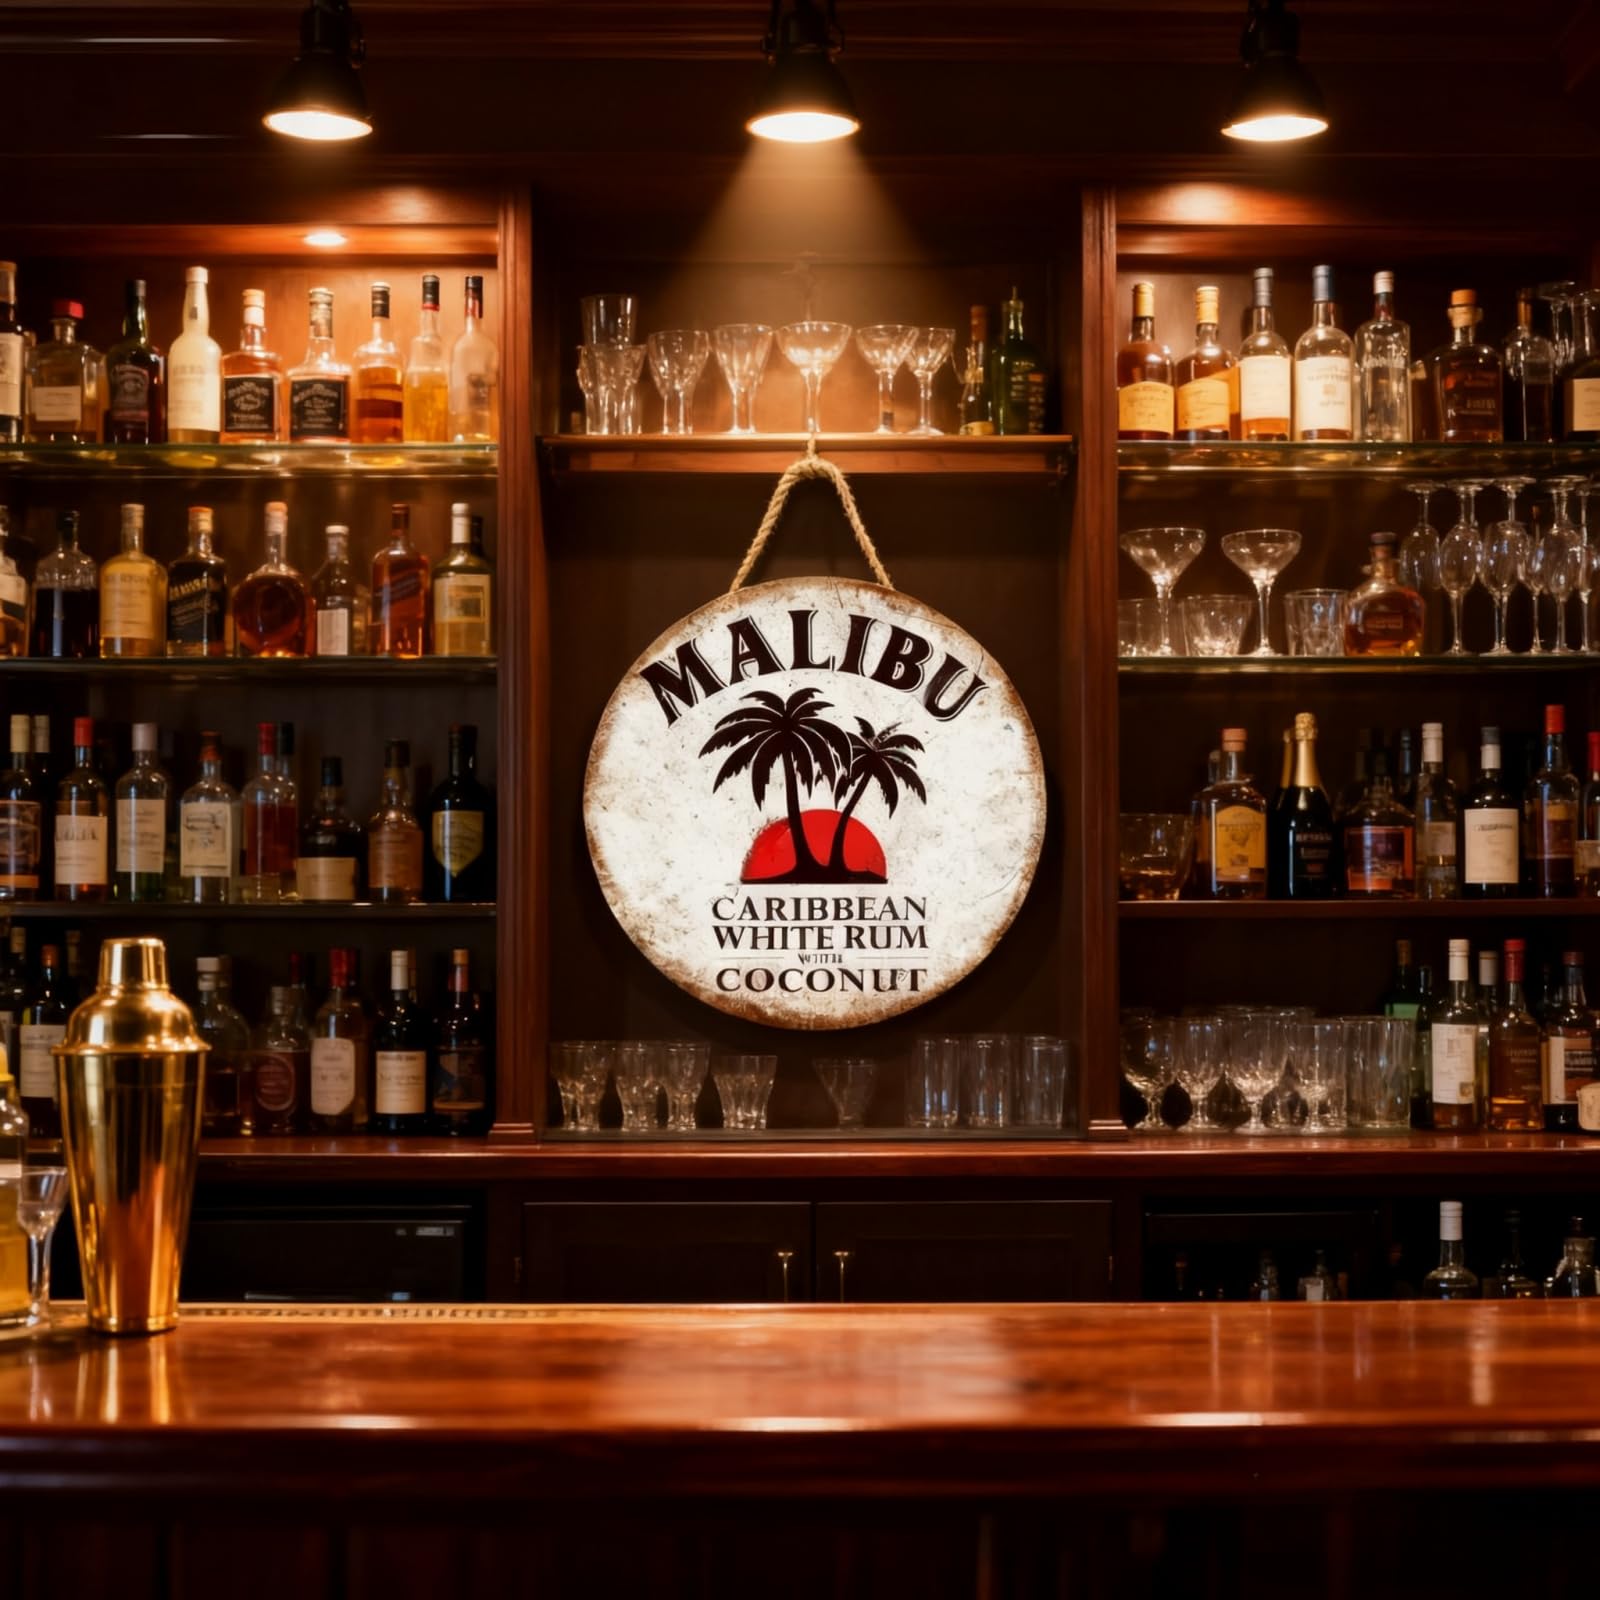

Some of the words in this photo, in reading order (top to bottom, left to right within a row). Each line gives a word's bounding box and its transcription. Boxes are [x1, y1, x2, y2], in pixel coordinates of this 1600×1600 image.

[640, 609, 990, 728] MALIBU
[711, 896, 927, 922] CARIBBEAN
[712, 925, 834, 950] WHITE
[843, 925, 929, 949] RUM
[716, 967, 928, 993] COCONUT
